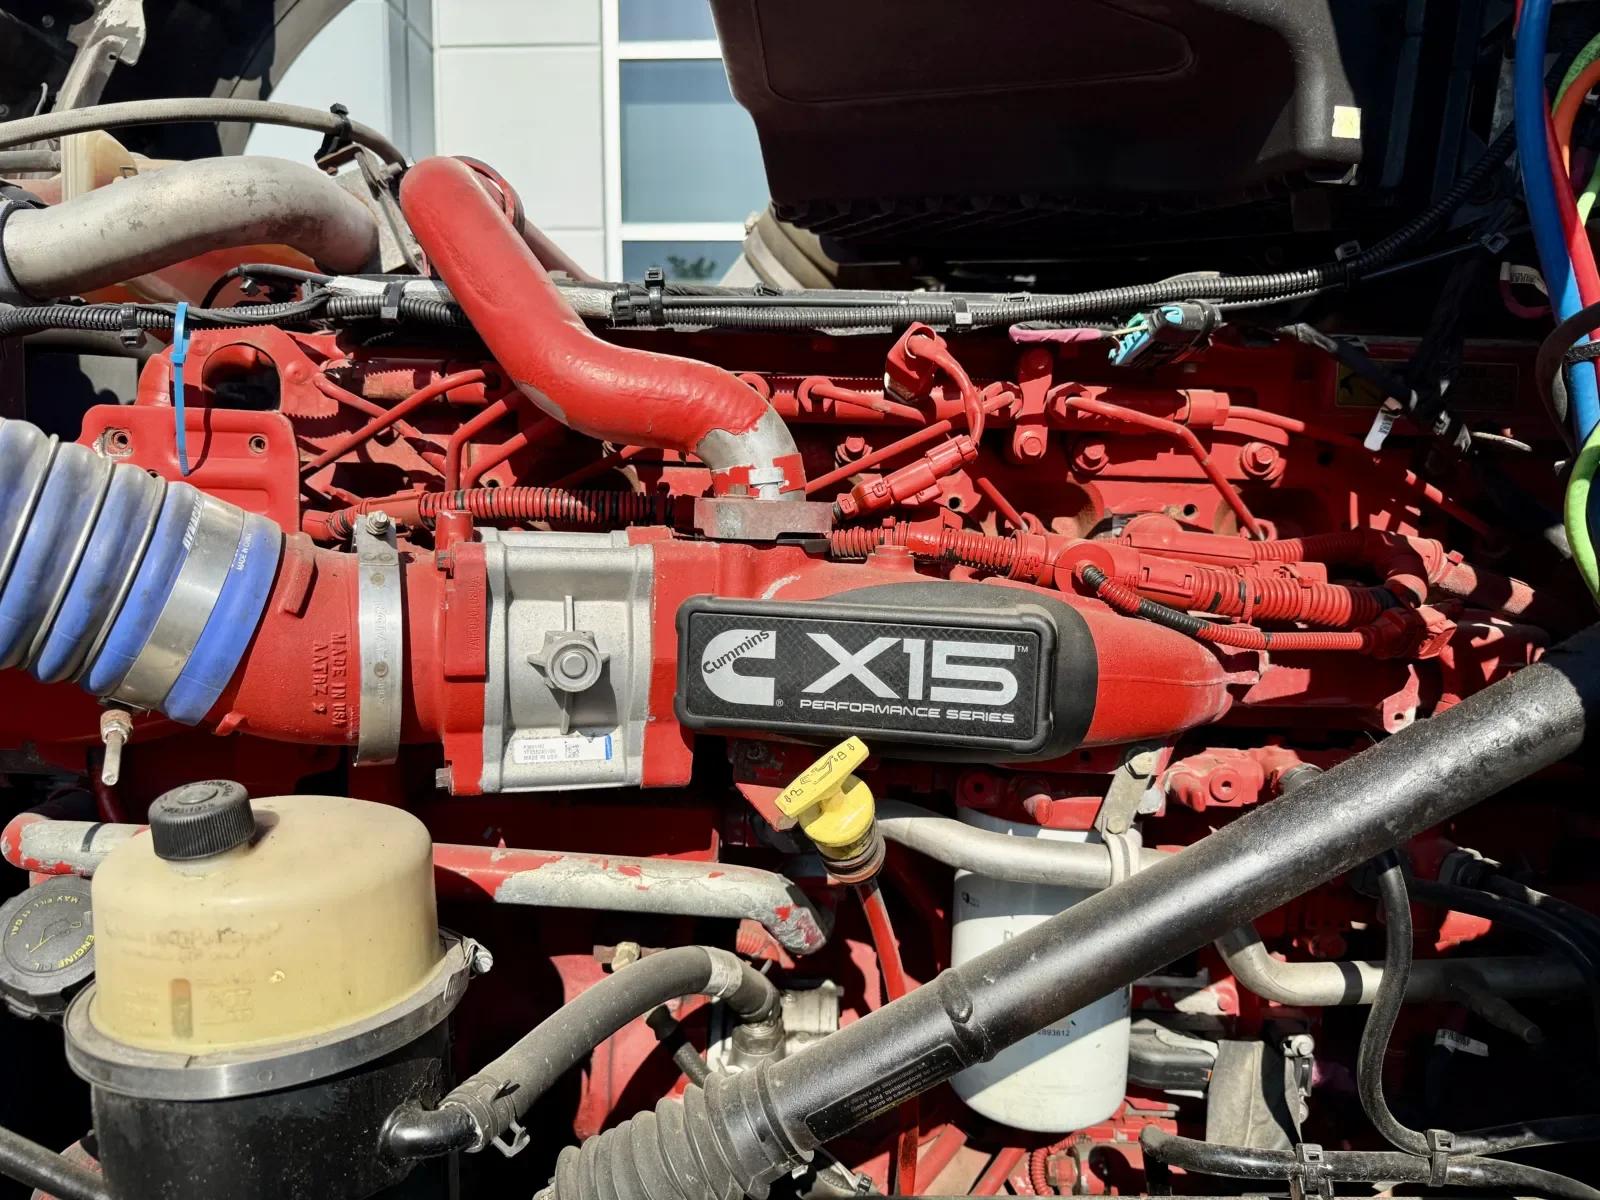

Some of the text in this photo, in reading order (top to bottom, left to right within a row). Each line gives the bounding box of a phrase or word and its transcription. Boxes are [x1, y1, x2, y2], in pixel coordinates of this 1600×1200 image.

[331, 633, 348, 678] MADE
[702, 630, 770, 674] Cummins
[331, 683, 347, 700] IN
[800, 699, 1015, 723] PERFORMANCE SERIES
[57, 934, 95, 969] ENGINE
